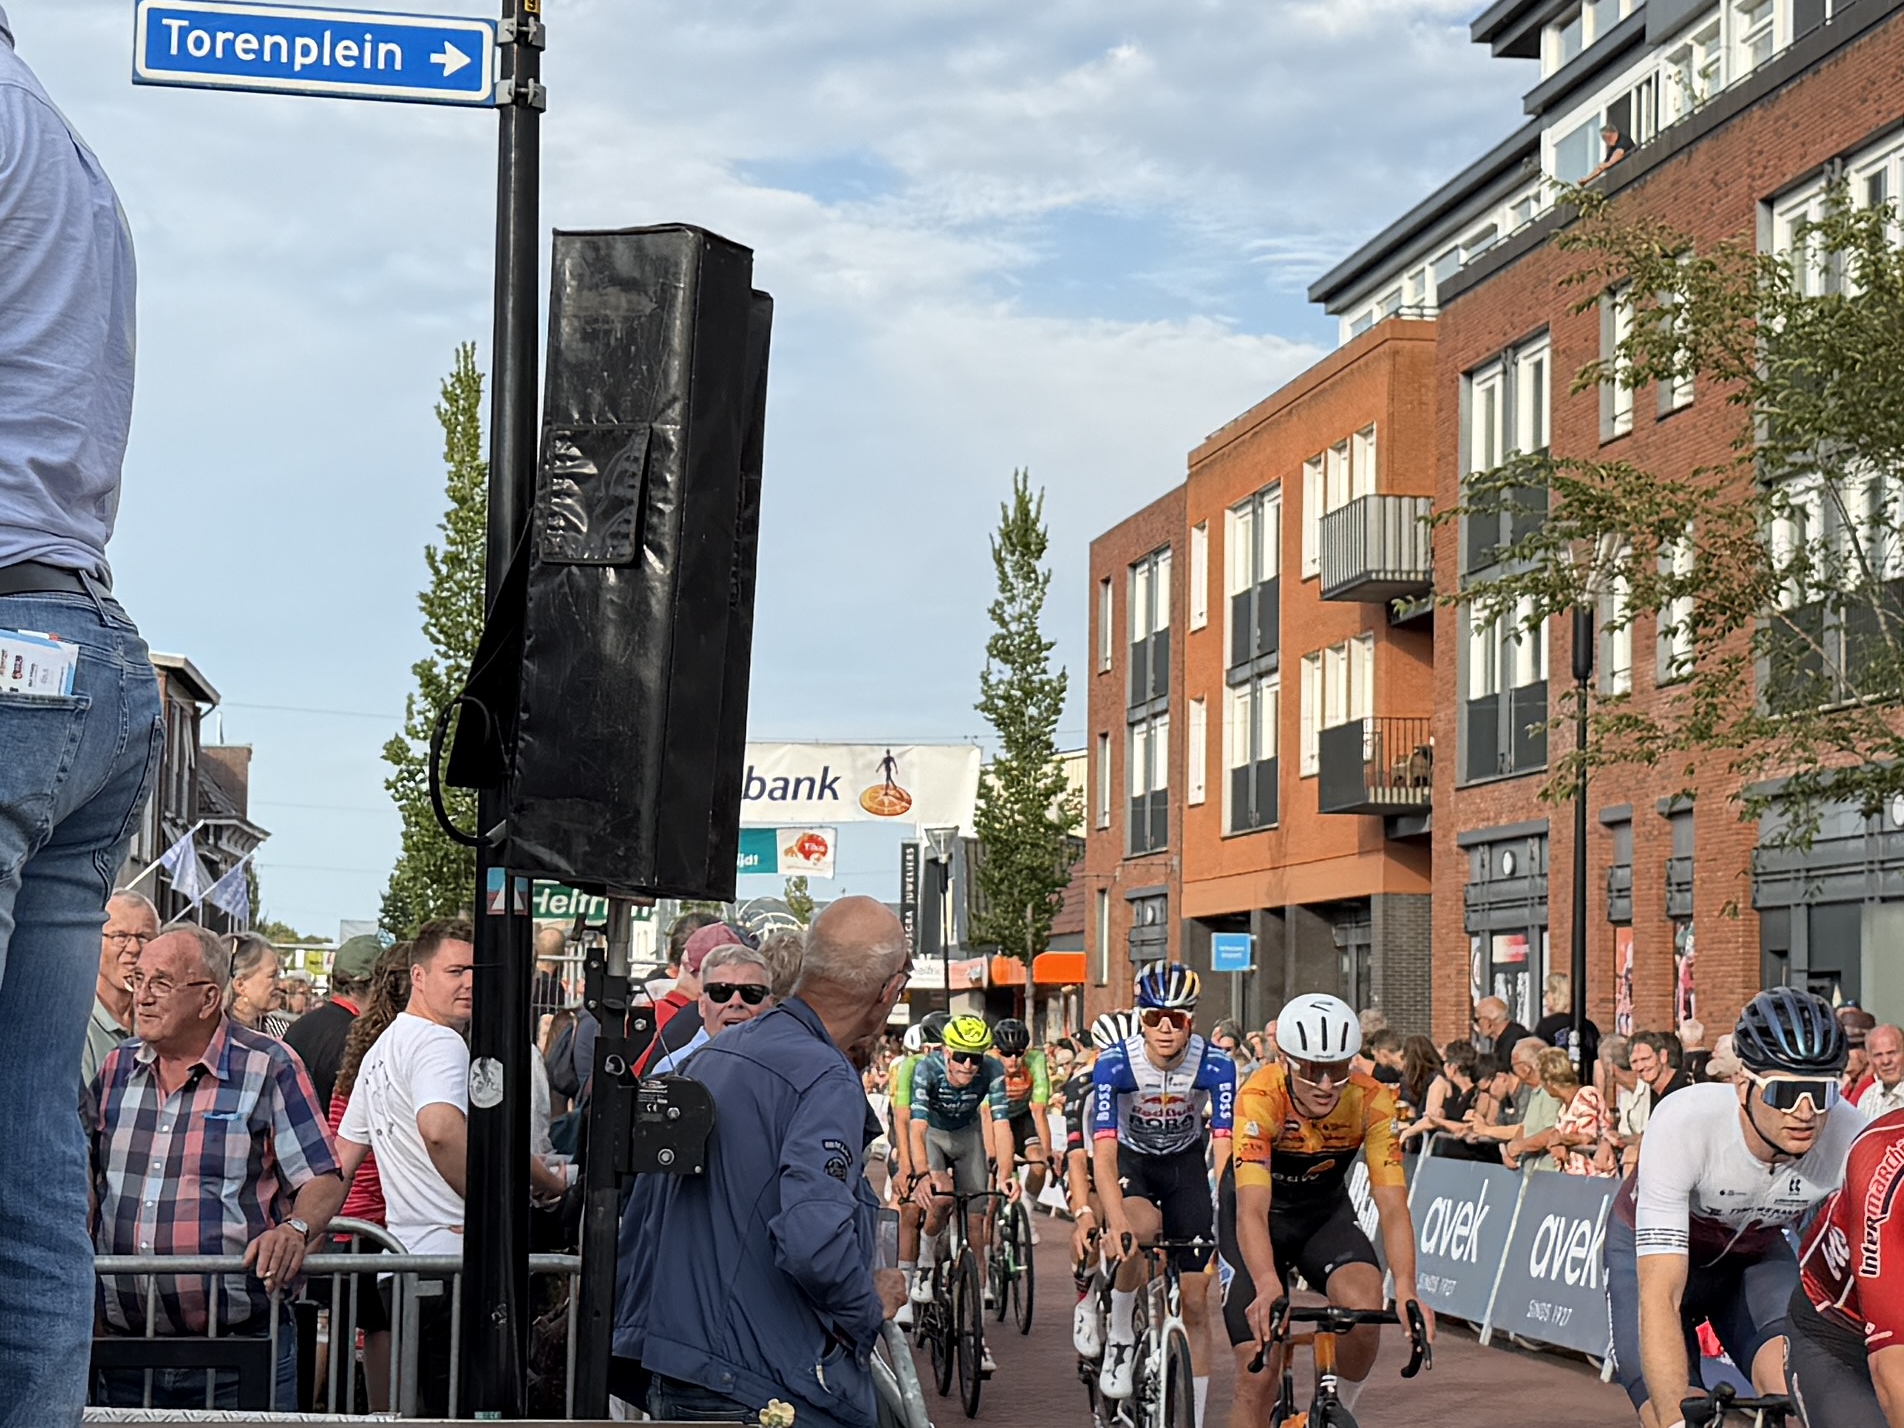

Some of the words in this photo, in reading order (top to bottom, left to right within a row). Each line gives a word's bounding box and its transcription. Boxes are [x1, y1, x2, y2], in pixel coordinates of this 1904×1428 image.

[161, 18, 402, 72] Torenplein
[1097, 1083, 1111, 1121] BOSS
[1219, 1082, 1232, 1119] BOSS
[1420, 1178, 1490, 1263] avek
[1529, 1193, 1608, 1289] avek
